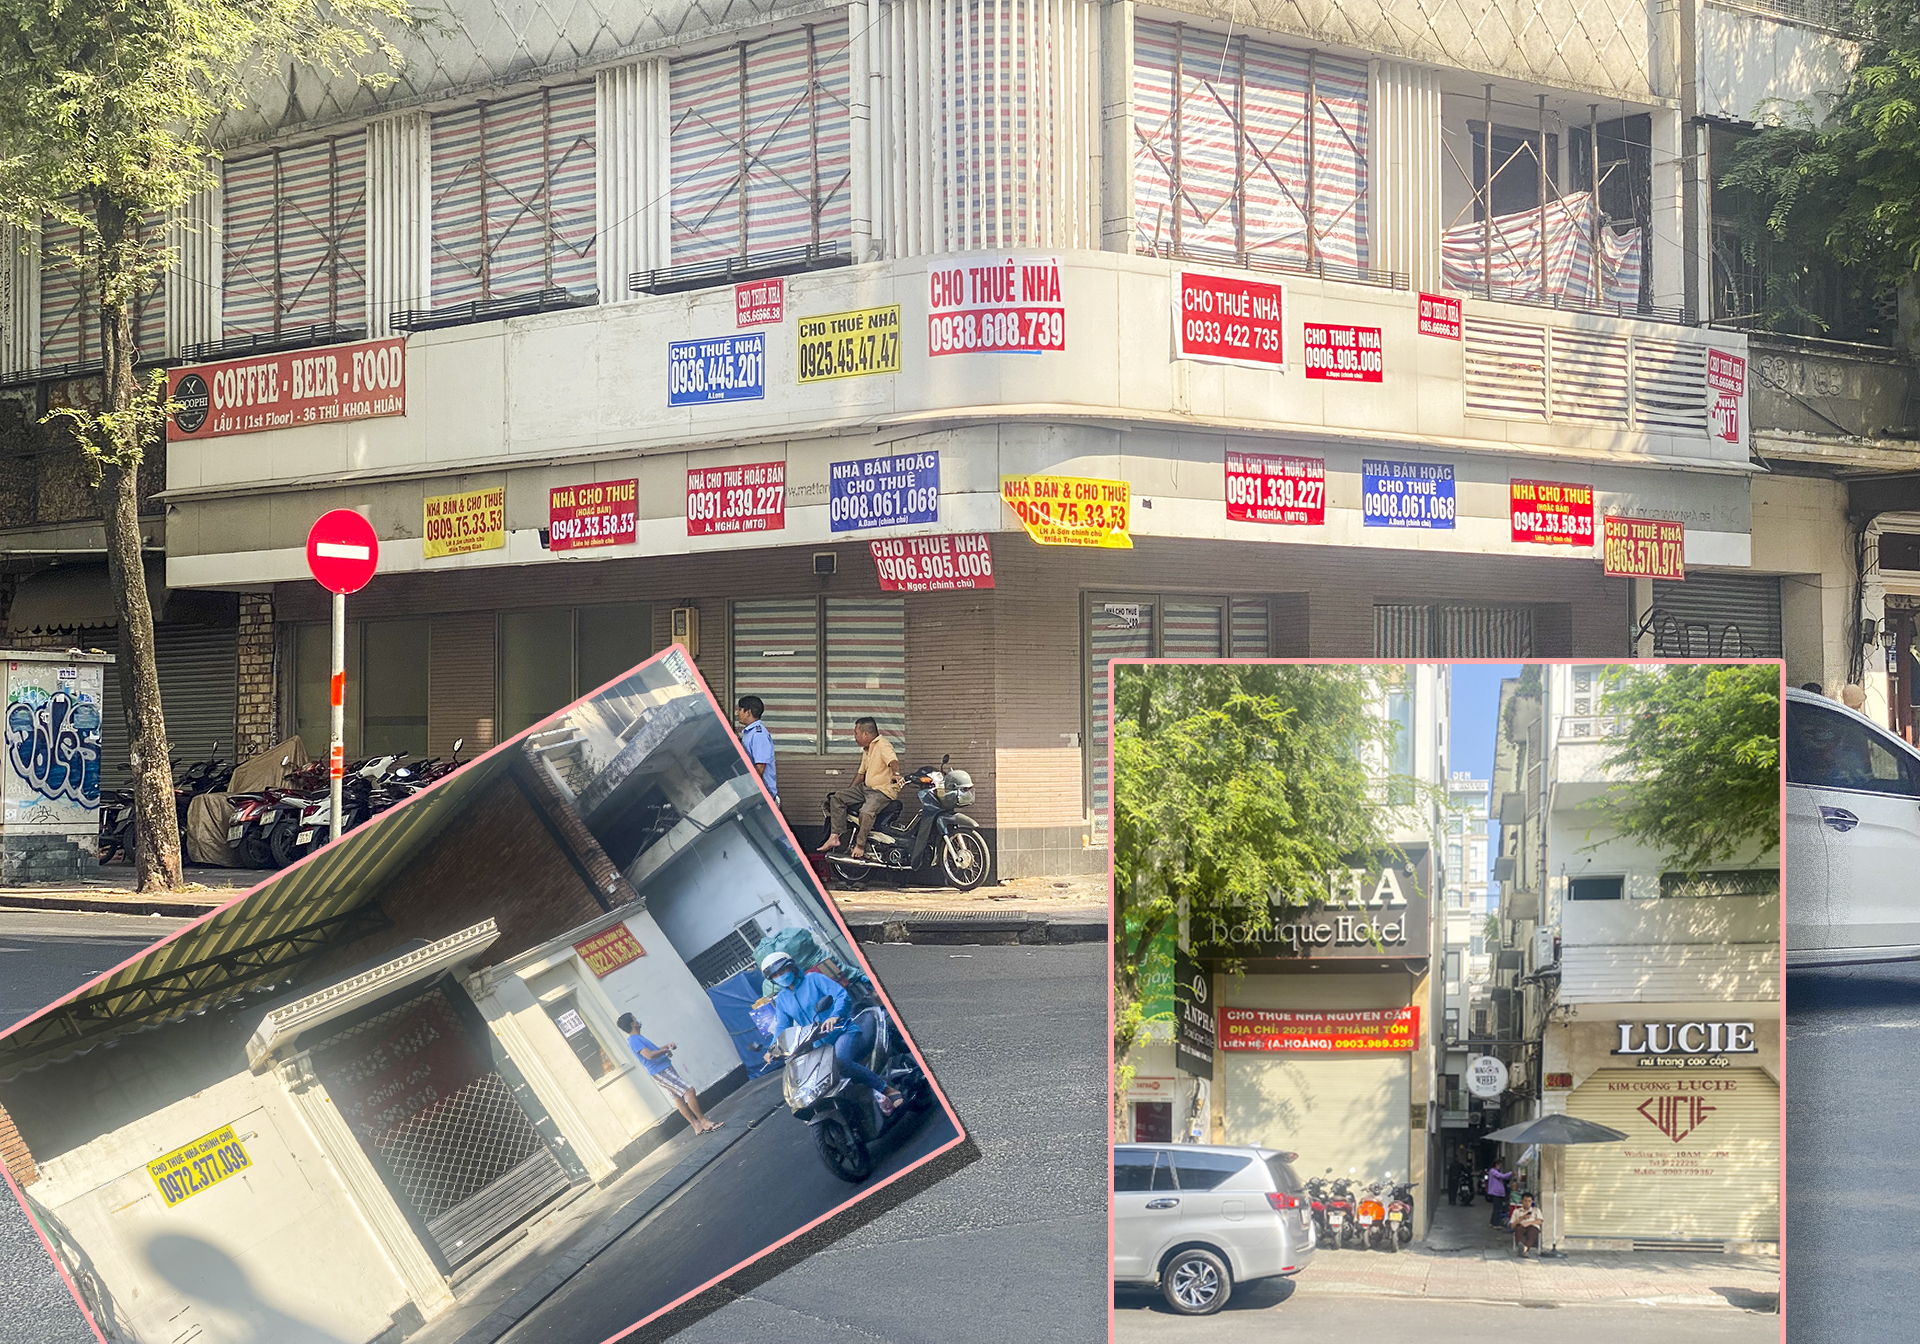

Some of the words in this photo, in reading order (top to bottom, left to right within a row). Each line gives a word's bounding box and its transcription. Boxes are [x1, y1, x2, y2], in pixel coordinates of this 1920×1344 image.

[739, 290, 750, 309] CHO
[751, 283, 766, 306] THUÊ
[768, 282, 780, 304] NHÀ
[931, 269, 963, 308] CHO
[969, 258, 1015, 304] THUÊ
[1022, 258, 1061, 302] NHÀ
[1185, 288, 1213, 313] CHO
[1216, 290, 1250, 317] THUÊ
[1253, 294, 1279, 321] NHÀ
[1421, 300, 1432, 318] CHO
[800, 322, 826, 338] CHO
[830, 314, 863, 334] THUÊ
[868, 309, 897, 328] NHÀ
[931, 312, 1062, 352] 0938.608.739
[1187, 319, 1221, 344] 0933
[1224, 324, 1250, 348] 422
[1254, 327, 1278, 351] 735
[672, 346, 696, 360] CHO
[700, 340, 731, 357] THUÊ
[735, 337, 762, 354] NHÀ
[1306, 328, 1326, 345] CHO
[1329, 328, 1356, 347] THUÊ
[1358, 329, 1380, 348] NHÀ
[801, 332, 898, 379] 0925.45.47.47
[1306, 347, 1381, 372] 0906.905.006
[214, 362, 279, 409] COFFEE
[292, 356, 338, 399] BEER
[352, 346, 401, 392] FOOD
[672, 353, 761, 394] 0936.445.201
[214, 414, 232, 431] LẦU
[236, 417, 240, 429] 1
[266, 410, 293, 426] Floor)
[303, 408, 316, 421] 36
[319, 399, 339, 418] THỦ
[343, 402, 370, 416] KHOA
[374, 394, 402, 412] HUÂN
[689, 471, 704, 490] NHÀ
[706, 472, 721, 489] CHO
[724, 467, 742, 487] THUÊ
[744, 466, 765, 488] HOẶC
[767, 464, 783, 483] BÁN
[833, 462, 859, 479] NHÀ
[864, 456, 890, 475] BÁN
[896, 450, 934, 472] HOẶC
[1228, 454, 1244, 473] NHÀ
[1246, 458, 1262, 474] CHO
[1264, 457, 1283, 476] THUÊ
[1285, 458, 1306, 480] HOẶC
[1307, 459, 1323, 478] BÁN
[1365, 461, 1390, 477] NHÀ
[1394, 462, 1416, 478] BÁN
[1420, 465, 1452, 482] HOẶC
[553, 488, 575, 508] NHÀ
[579, 488, 602, 505] CHO
[606, 480, 635, 502] THUÊ
[847, 479, 875, 494] CHO
[879, 472, 915, 490] THUÊ
[1004, 477, 1030, 497] NHÀ
[1034, 478, 1058, 498] BÁN
[1063, 483, 1071, 499] &
[1075, 483, 1098, 500] CHO
[1102, 483, 1126, 502] THUÊ
[1228, 476, 1324, 509] 0931.339.227
[1378, 480, 1404, 493] CHO
[1406, 480, 1436, 495] THUÊ
[1513, 481, 1536, 500] NHÀ
[1538, 486, 1560, 502] CHO
[1563, 486, 1591, 504] THUÊ
[427, 499, 440, 516] NHÀ
[443, 497, 457, 515] BÁN
[460, 499, 464, 512] &
[467, 495, 481, 511] CHO
[484, 488, 502, 508] THUÊ
[688, 486, 783, 520] 0931.339.227
[832, 487, 936, 521] 0908.061.068
[1365, 493, 1454, 520] 0908.061.068
[427, 509, 502, 541] 0909.75.33.53
[552, 513, 634, 540] 0942.33.58.33
[705, 523, 712, 532] A.
[715, 519, 740, 531] NGHĨA
[743, 519, 766, 531] (MTG)
[1246, 508, 1254, 518] A.
[1257, 508, 1282, 520] NGHĨA
[1284, 511, 1308, 524] (MTG)
[1514, 512, 1591, 535] 0942.33.58.33
[1606, 522, 1628, 537] CHO
[1631, 523, 1658, 539] THUÊ
[1660, 525, 1682, 541] NHÀ
[871, 540, 904, 557] CHO
[1606, 538, 1683, 576] 0963.570.974
[877, 553, 991, 580] 0906.905.006
[907, 582, 927, 592] Ngọc
[930, 580, 954, 591] (chính
[956, 579, 975, 588] chủ)
[1336, 912, 1407, 942] Hotel
[1227, 1011, 1254, 1020] CHO
[1230, 1025, 1252, 1035] ĐỊA
[1254, 1024, 1279, 1034] CHỈ:
[1282, 1026, 1313, 1034] 202/1
[1318, 1024, 1333, 1034] LÊ
[1337, 1024, 1380, 1034] THÁNH
[1383, 1024, 1408, 1034] TÔN
[1618, 1022, 1755, 1053] LUCIE
[1223, 1038, 1246, 1048] LIÊN
[1248, 1038, 1265, 1050] HỆ:
[1268, 1037, 1332, 1049] (A.HOÀNG)
[1335, 1039, 1414, 1048] 0903.989.539
[1657, 1057, 1685, 1069] trang
[1709, 1053, 1729, 1068] cấp
[1547, 1074, 1570, 1087] 200
[1608, 1082, 1630, 1090] KIM
[1632, 1081, 1670, 1090] CƯƠNG
[1677, 1080, 1738, 1090] LUCIE
[151, 1163, 167, 1176] CHO
[166, 1152, 185, 1168] THUÊ
[184, 1144, 200, 1160] NHÀ
[219, 1128, 234, 1143] CHỦ
[159, 1142, 247, 1203] 0972.377.039
